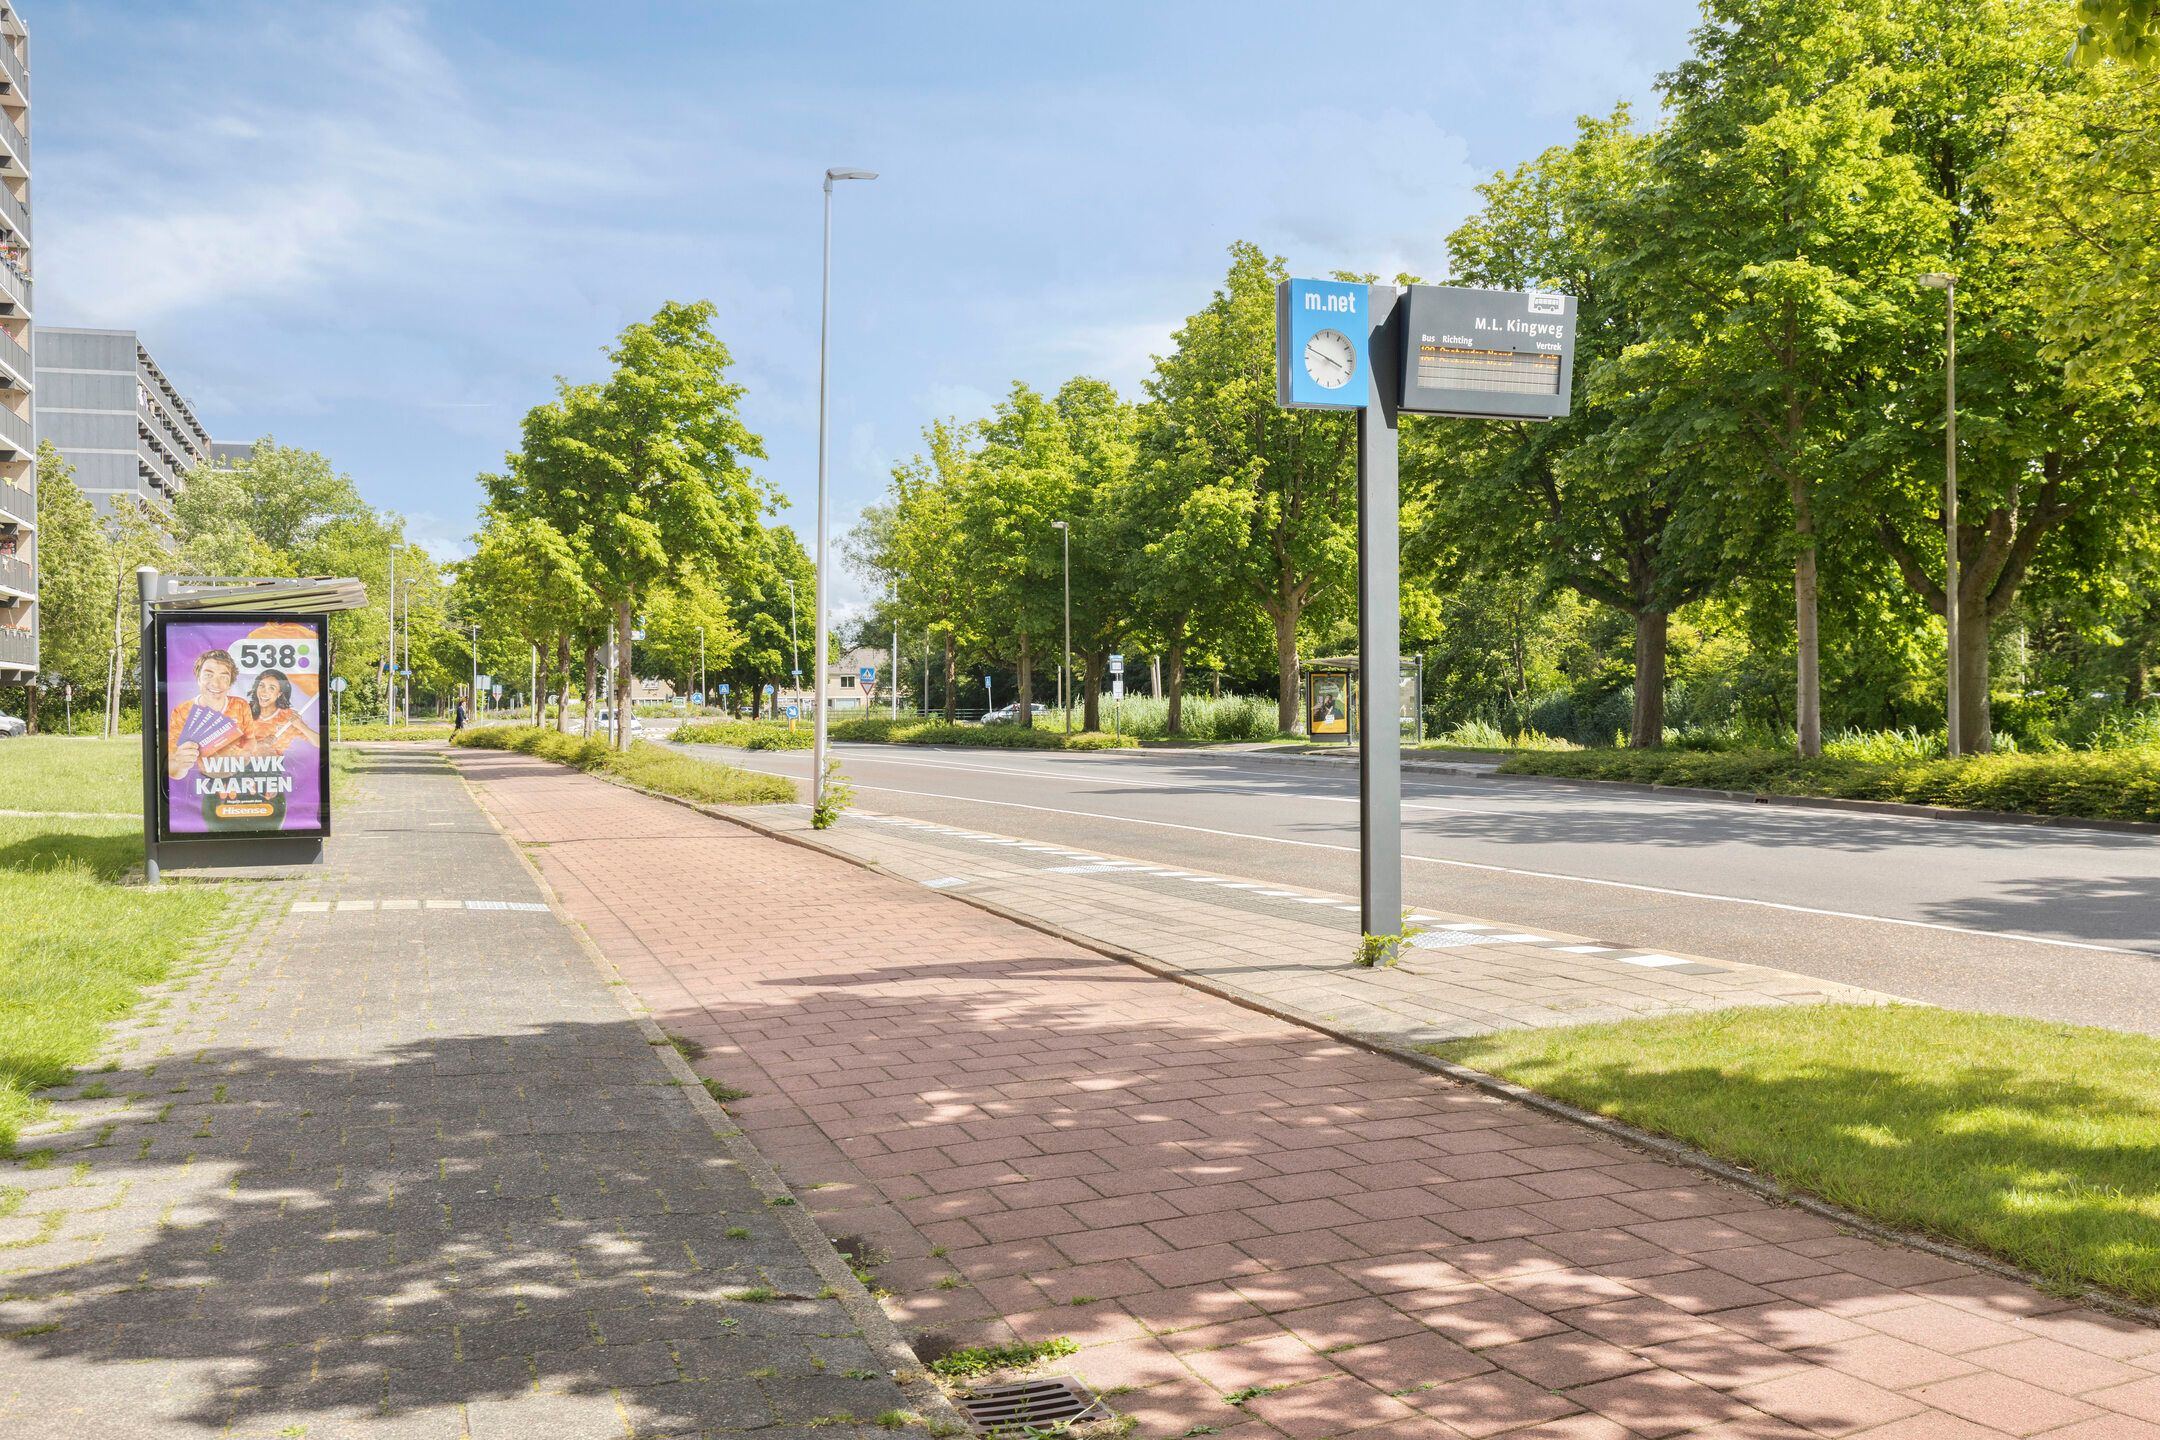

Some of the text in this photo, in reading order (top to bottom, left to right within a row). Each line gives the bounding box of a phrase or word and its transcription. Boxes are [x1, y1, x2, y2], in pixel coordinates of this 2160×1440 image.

[1305, 291, 1356, 313] m.net
[1475, 317, 1564, 338] M.L. Kingweg
[1421, 334, 1436, 343] Bus
[1442, 335, 1473, 347] Richting
[1536, 341, 1562, 351] Vertrek
[240, 644, 296, 668] 538
[202, 755, 286, 773] WIN WK
[196, 776, 292, 795] KAARTEN
[222, 807, 267, 815] Hisense
